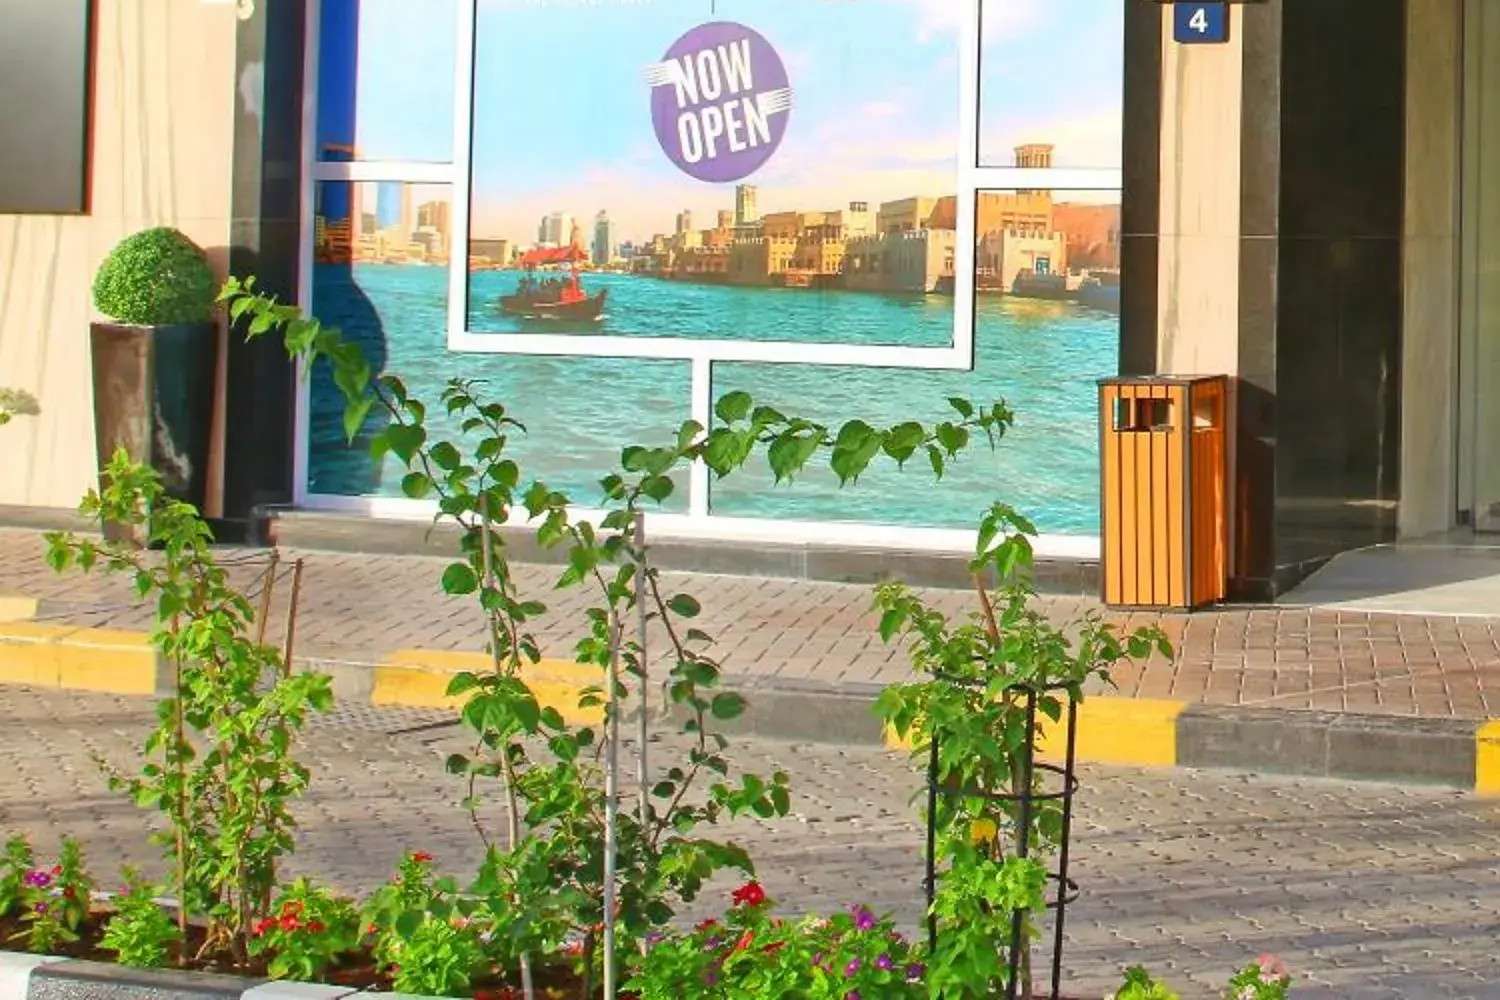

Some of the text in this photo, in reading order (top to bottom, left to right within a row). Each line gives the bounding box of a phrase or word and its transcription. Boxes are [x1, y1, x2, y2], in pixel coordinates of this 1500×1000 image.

[1189, 8, 1208, 32] 4
[664, 39, 753, 109] NOW
[677, 97, 772, 162] OPEN
